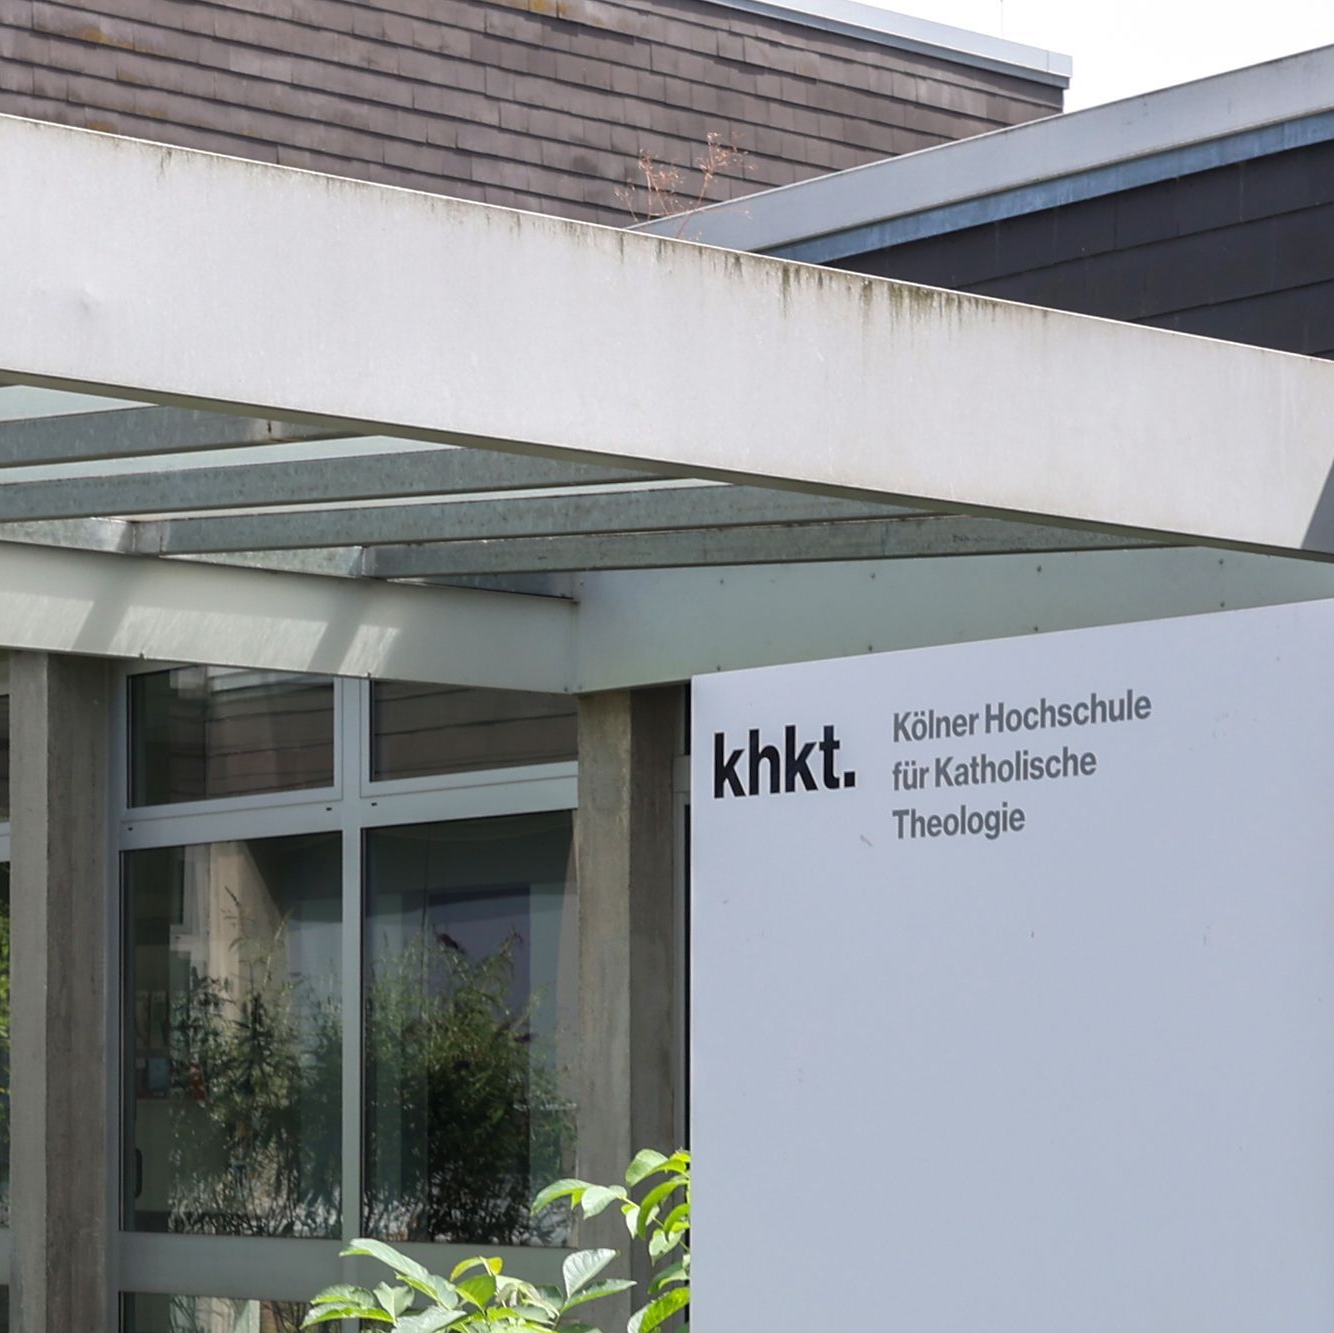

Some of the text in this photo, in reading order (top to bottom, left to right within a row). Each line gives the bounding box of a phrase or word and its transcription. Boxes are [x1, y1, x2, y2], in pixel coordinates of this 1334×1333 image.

[893, 688, 1152, 743] Kölner Hochschule
[713, 724, 856, 800] khkt.
[892, 746, 1097, 792] für Katholische
[892, 801, 1026, 841] Theologie
